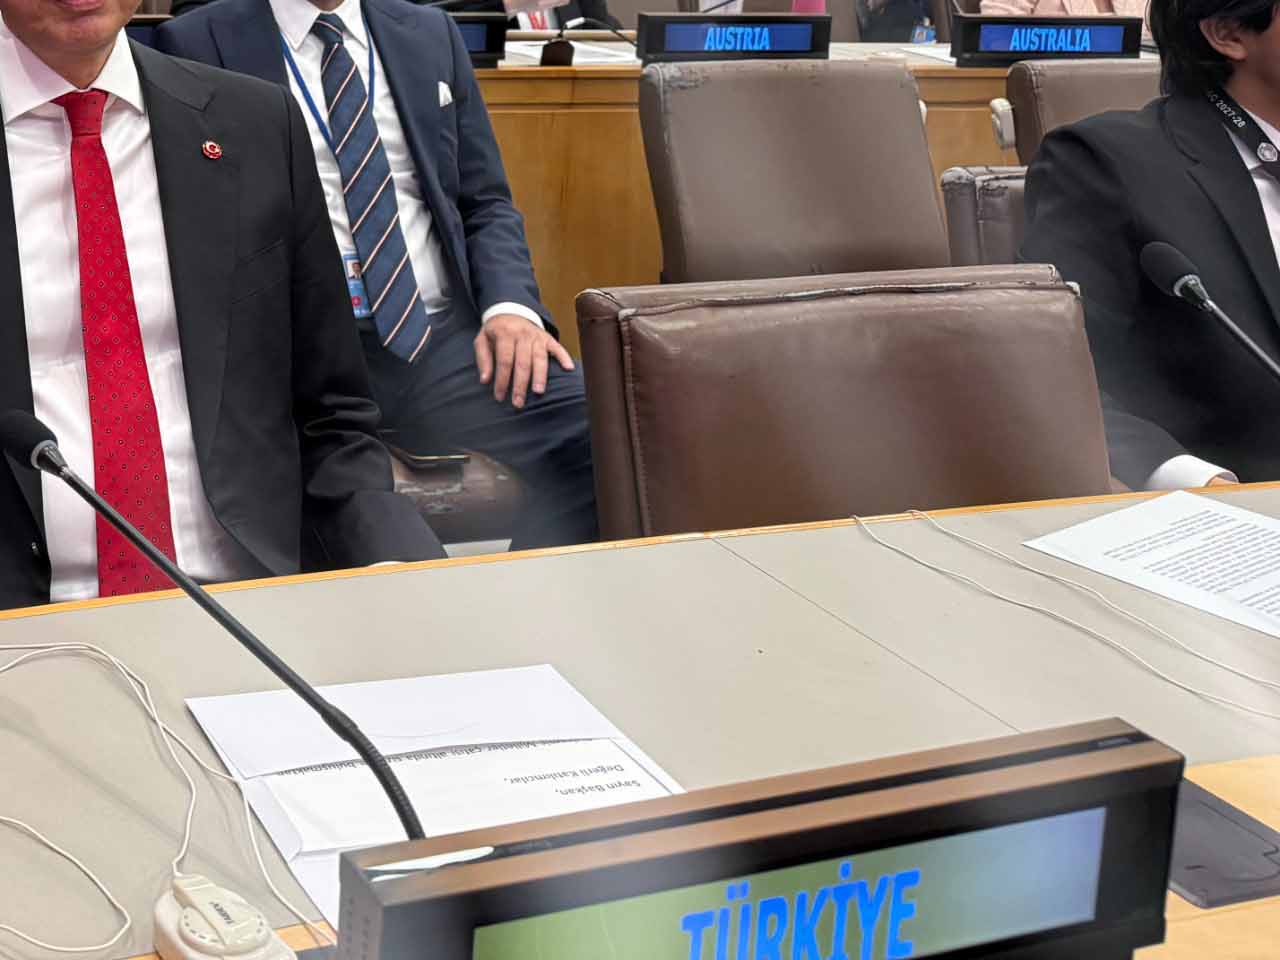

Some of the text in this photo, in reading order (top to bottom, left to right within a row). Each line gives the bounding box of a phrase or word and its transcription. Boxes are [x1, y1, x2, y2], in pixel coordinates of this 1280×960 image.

[703, 26, 770, 51] AUSTRIA
[1009, 26, 1091, 52] AUSTRALIA
[681, 861, 920, 960] TÜRKİYE
